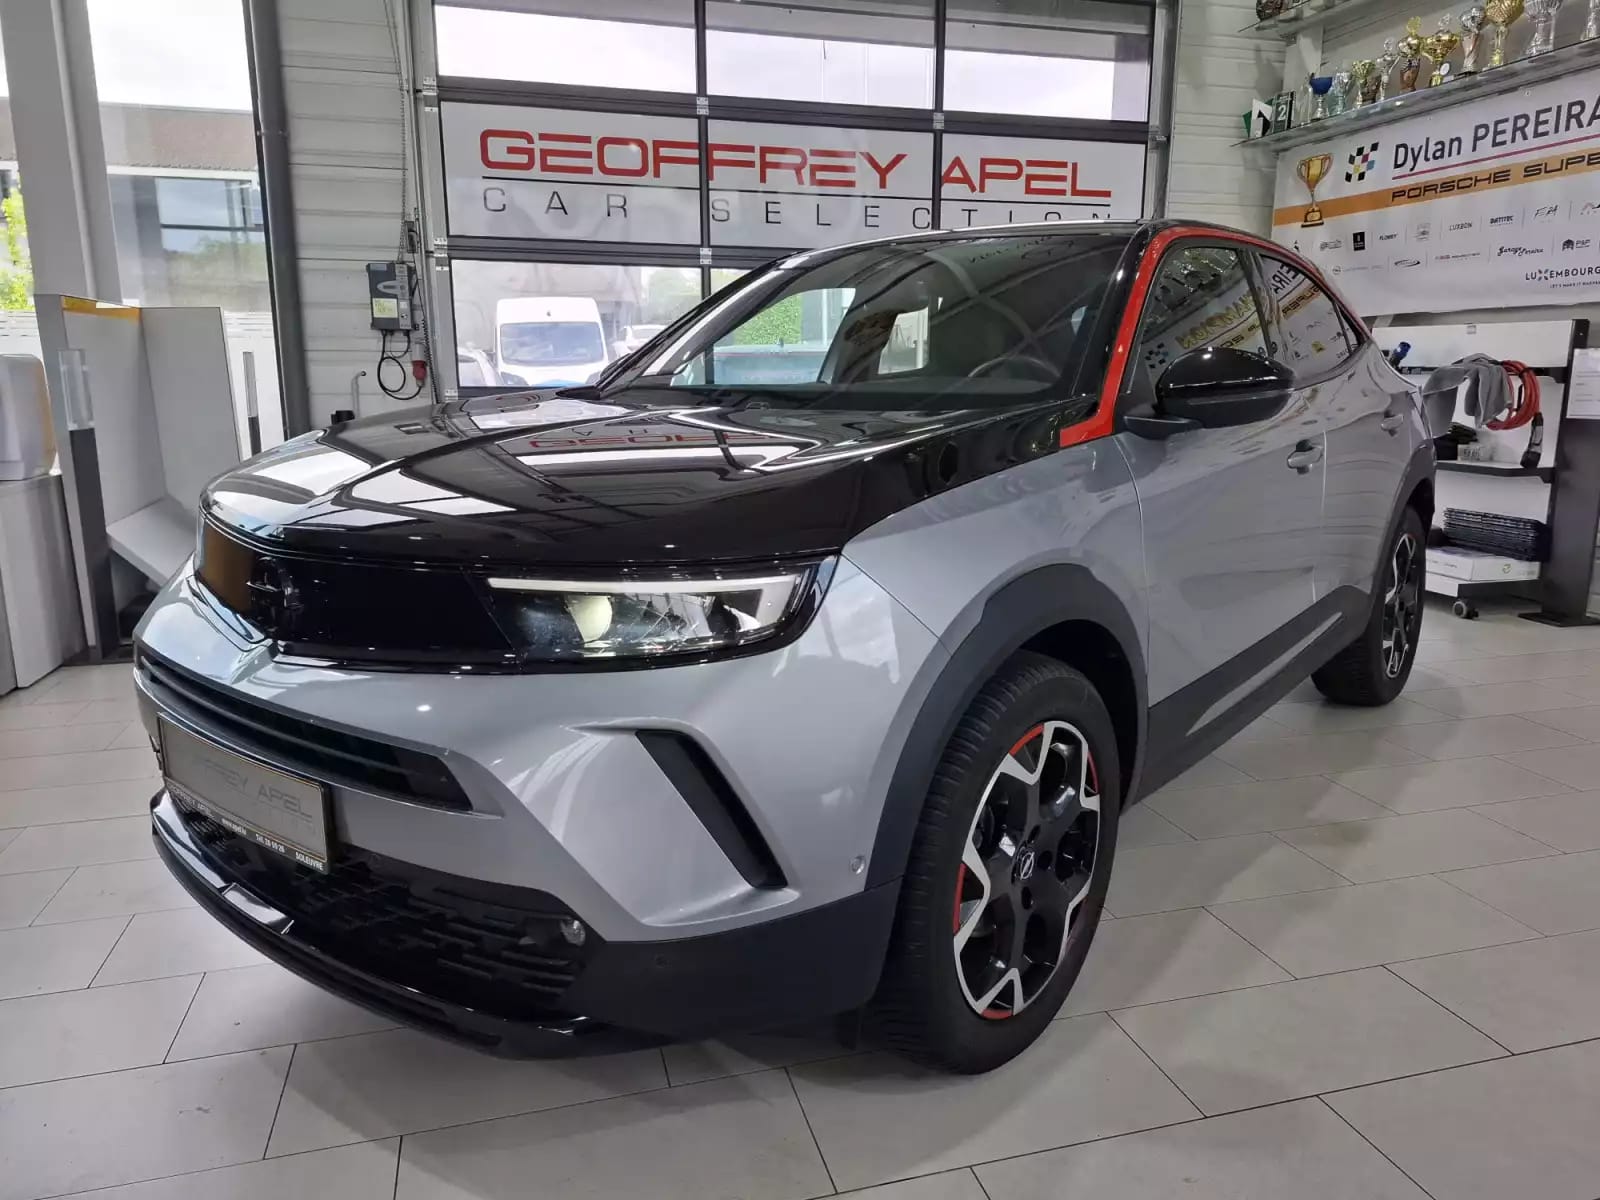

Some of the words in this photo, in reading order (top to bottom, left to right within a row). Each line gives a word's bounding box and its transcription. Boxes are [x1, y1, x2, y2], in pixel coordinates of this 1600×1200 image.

[1278, 105, 1287, 120] 2
[480, 129, 907, 189] GEOFFREY
[941, 156, 1111, 197] APEL
[1393, 136, 1462, 172] Dylan
[1392, 169, 1511, 202] PORSCHE
[483, 187, 628, 218] CAR
[1525, 266, 1600, 281] LUXEMBOURG
[295, 851, 324, 871] SOLEUVRE
